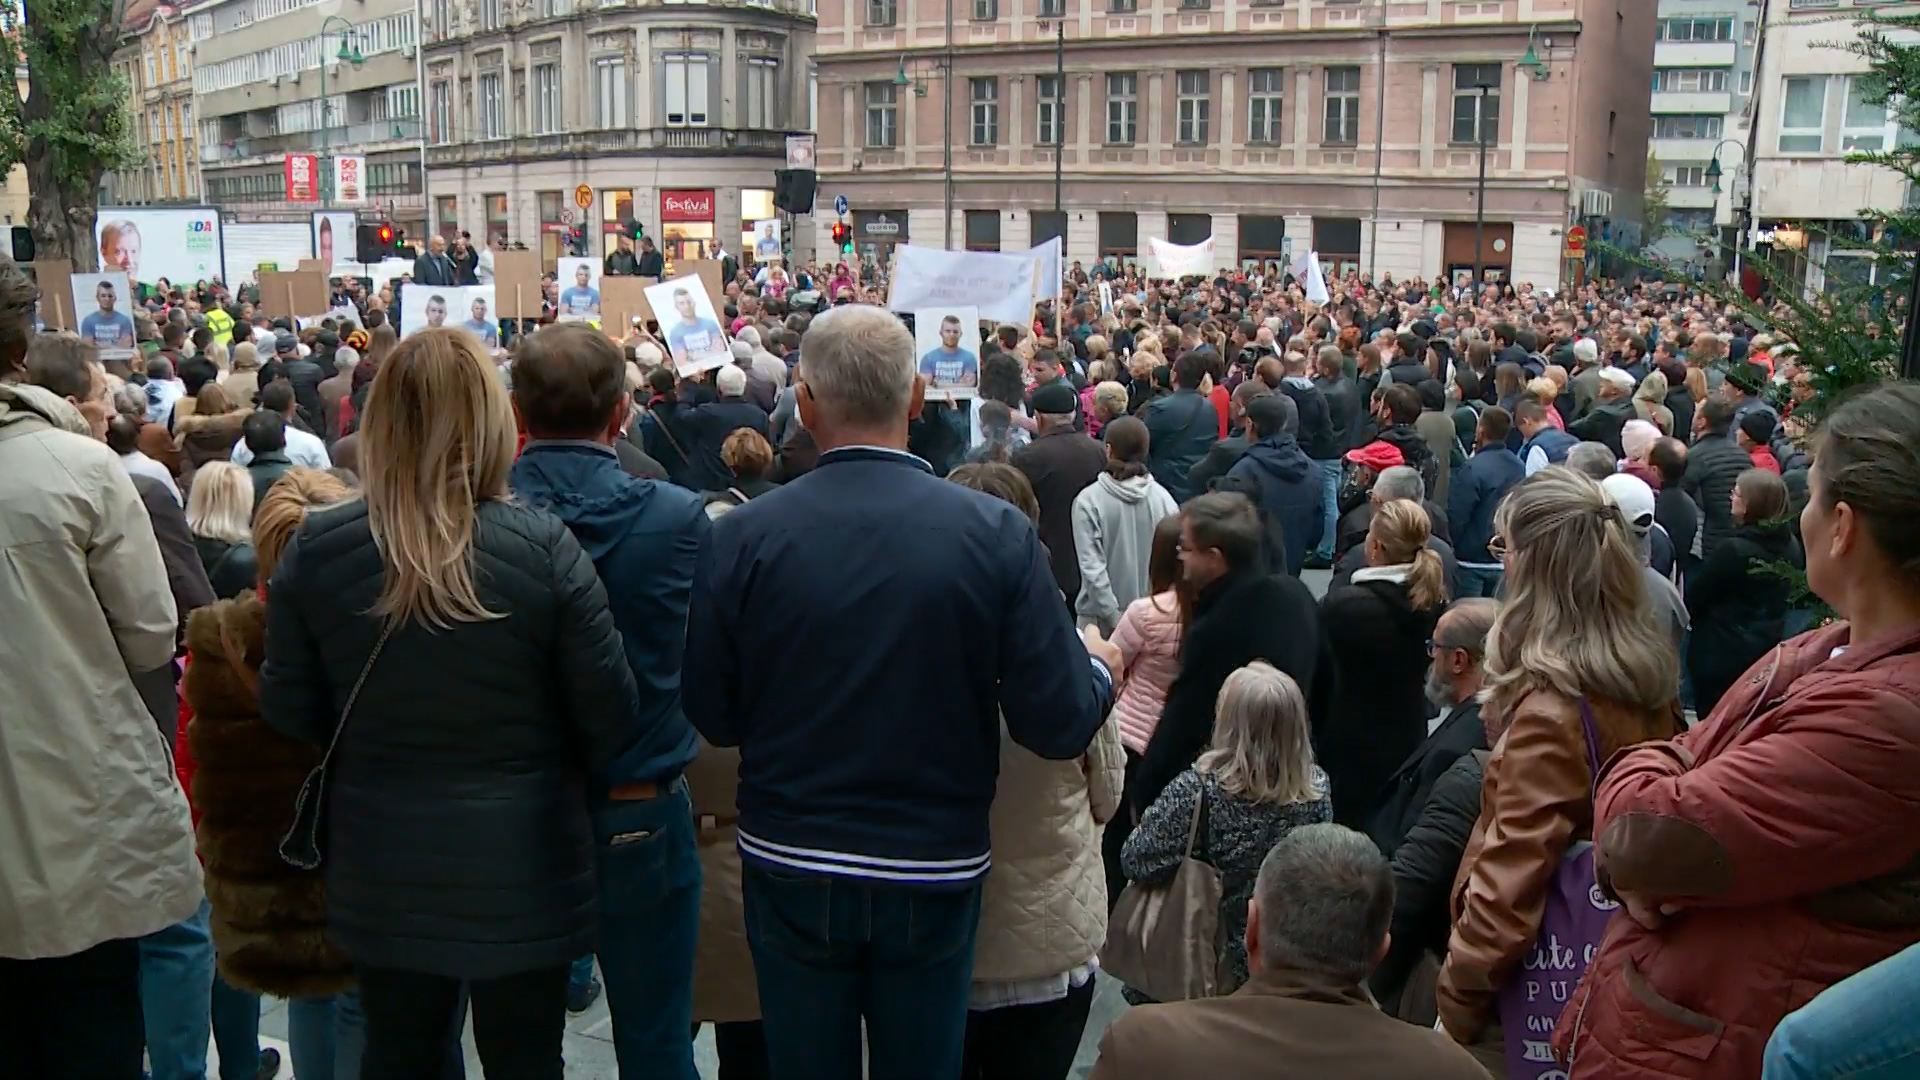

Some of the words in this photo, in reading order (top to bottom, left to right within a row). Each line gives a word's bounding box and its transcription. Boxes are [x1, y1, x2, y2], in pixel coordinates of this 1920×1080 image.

[665, 197, 709, 210] festival
[187, 221, 212, 232] SDA
[1527, 1015, 1555, 1032] an
